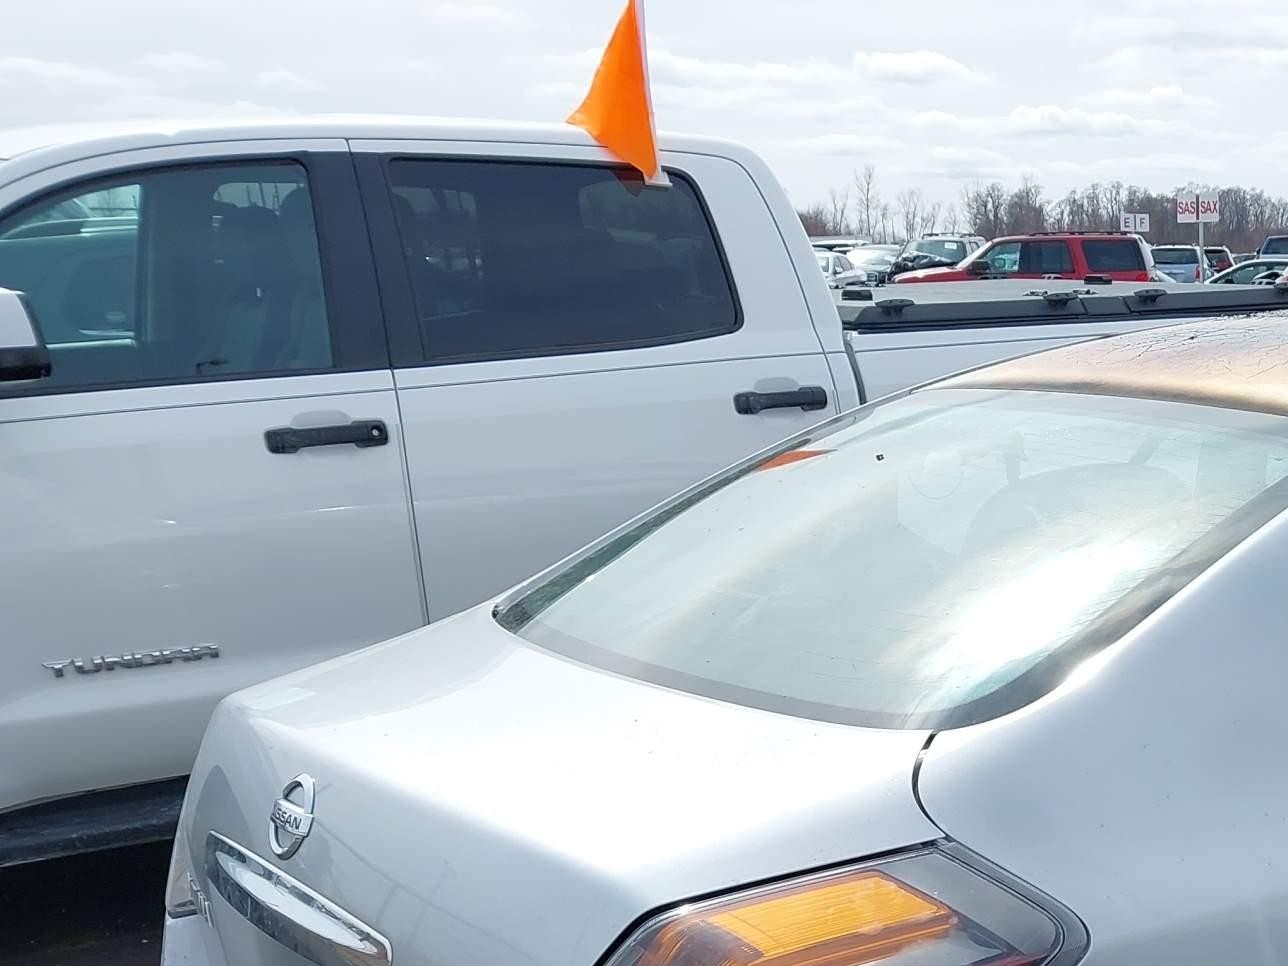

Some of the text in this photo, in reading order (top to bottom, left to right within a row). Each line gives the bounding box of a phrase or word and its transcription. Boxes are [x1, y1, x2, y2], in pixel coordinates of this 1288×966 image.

[1177, 200, 1218, 215] SAS SAX
[1124, 216, 1146, 228] E F
[41, 643, 220, 678] TUNDRA
